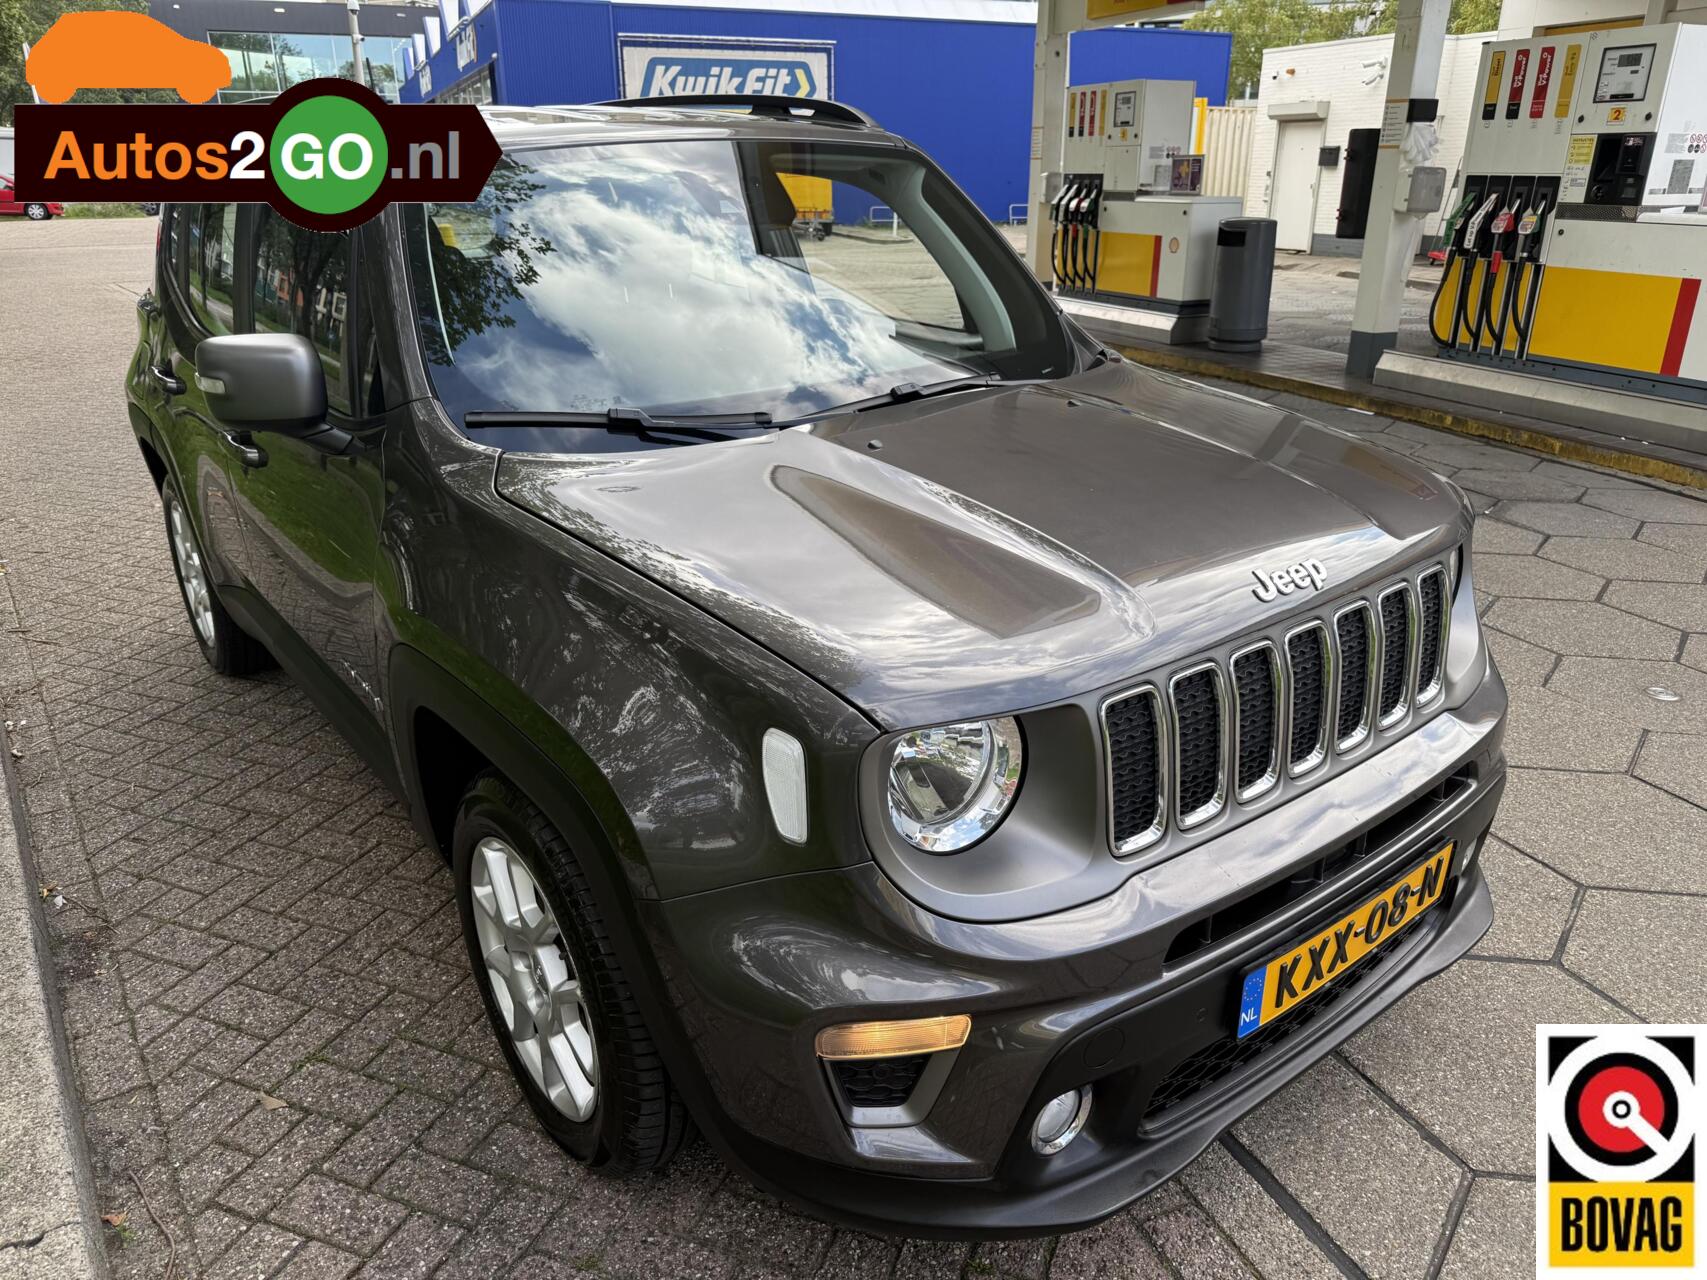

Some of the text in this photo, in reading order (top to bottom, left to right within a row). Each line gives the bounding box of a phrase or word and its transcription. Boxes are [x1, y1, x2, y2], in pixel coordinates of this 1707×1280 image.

[1613, 109, 1621, 121] 2
[1251, 558, 1328, 603] Jeep
[1274, 856, 1445, 1009] KXX-08-N
[1240, 1007, 1258, 1027] NL
